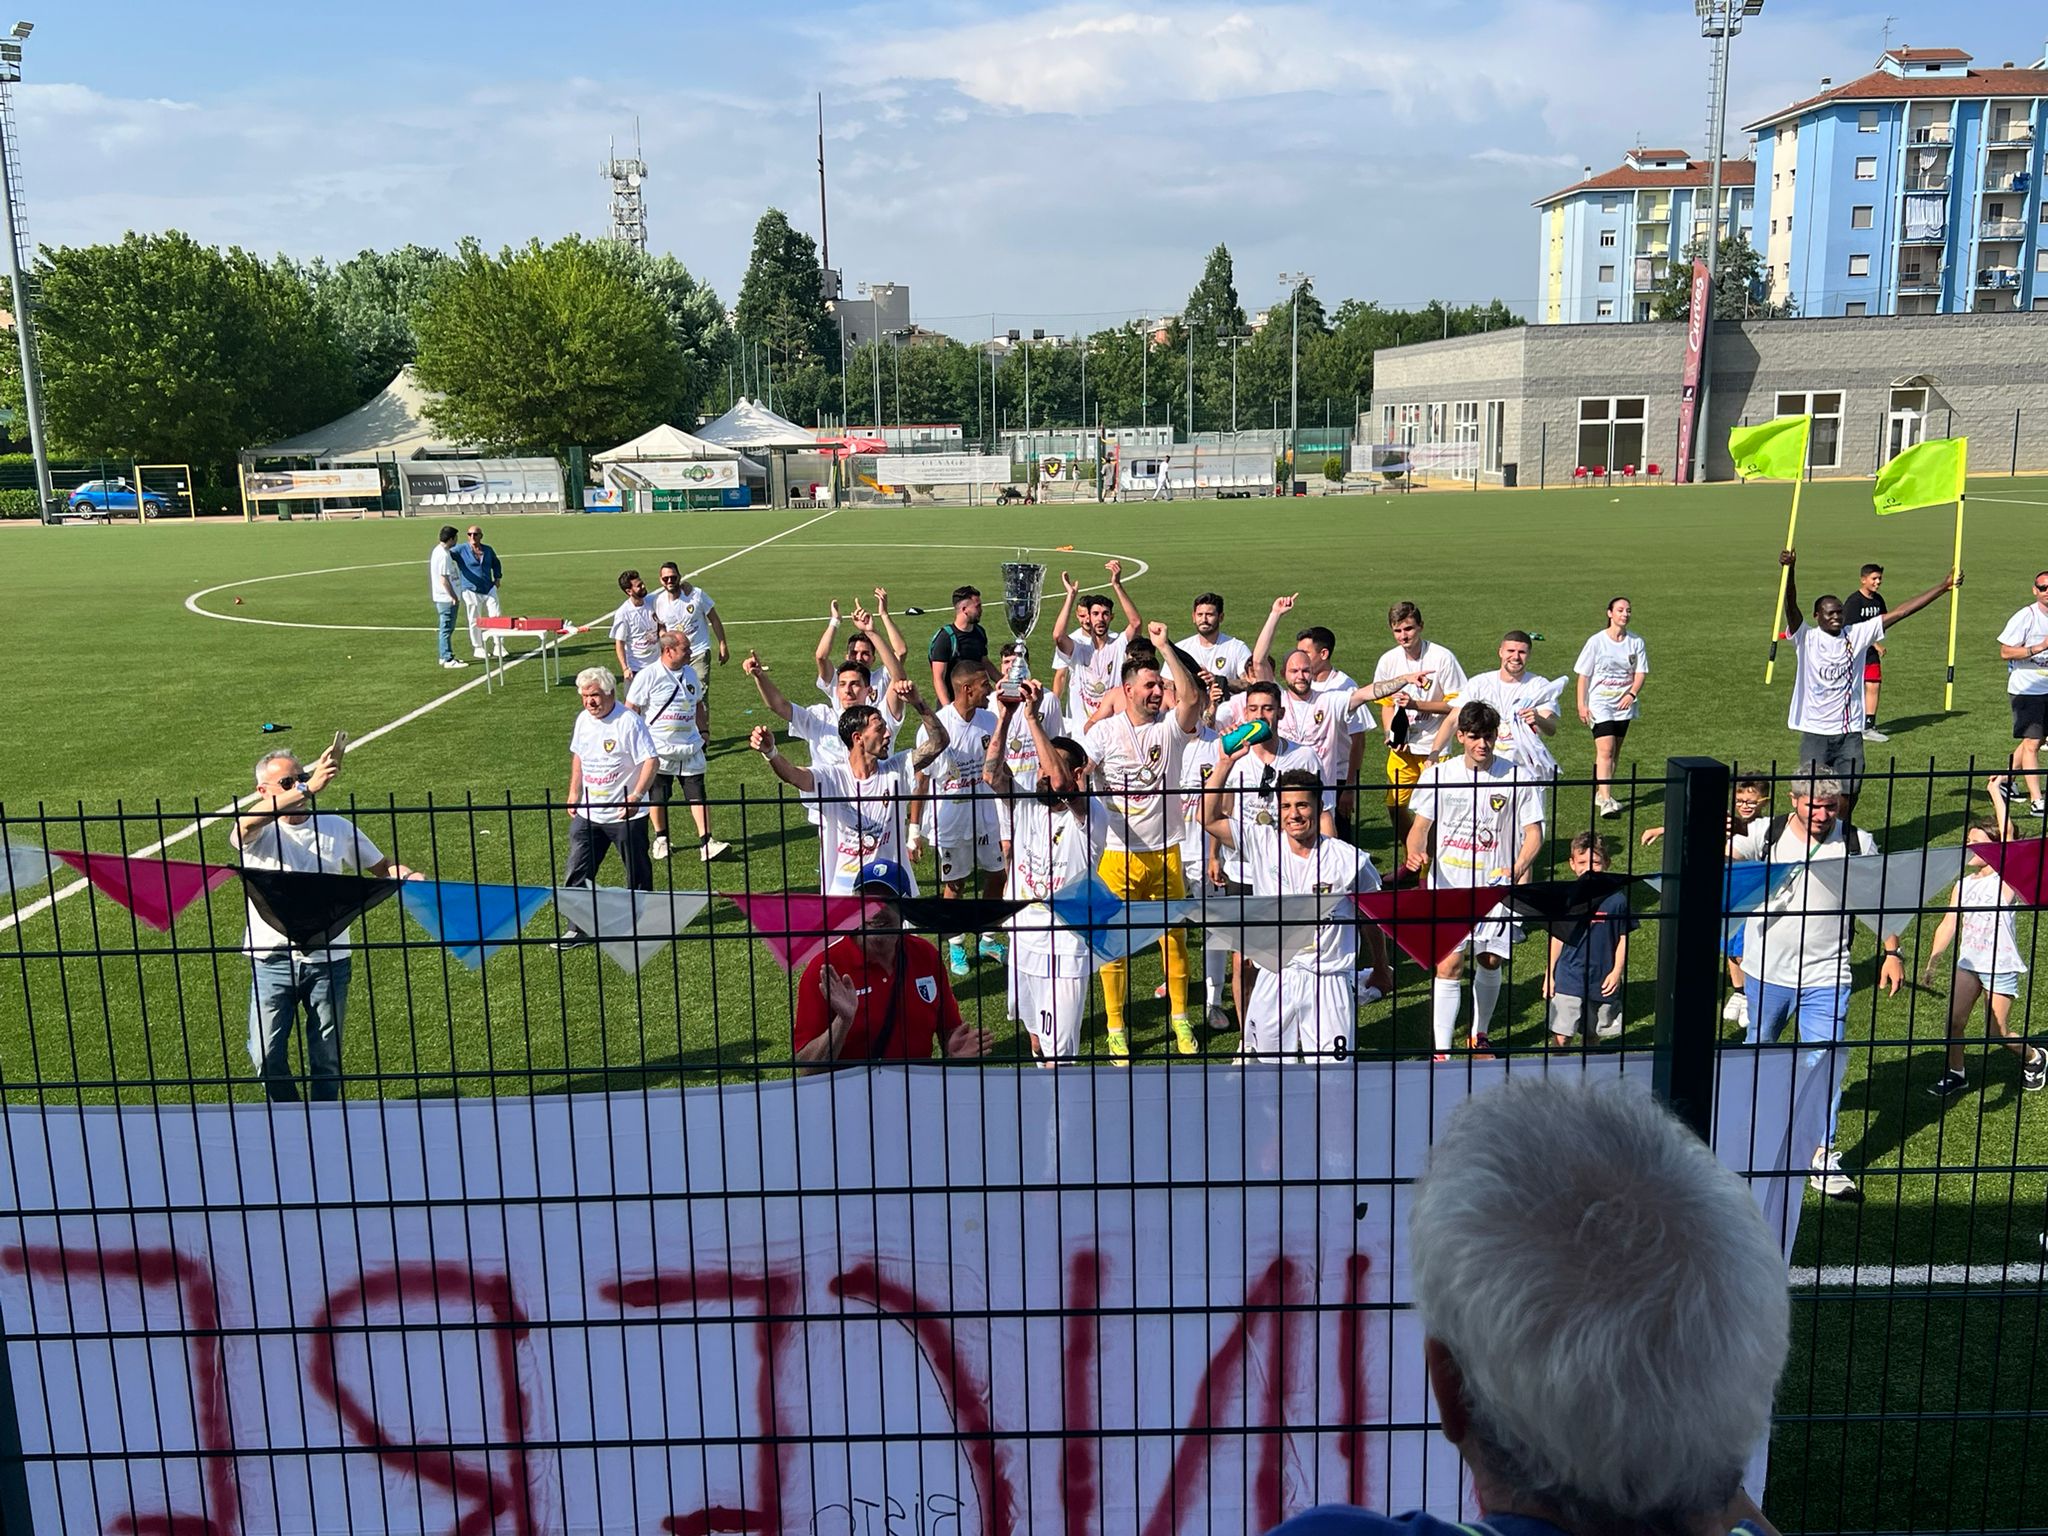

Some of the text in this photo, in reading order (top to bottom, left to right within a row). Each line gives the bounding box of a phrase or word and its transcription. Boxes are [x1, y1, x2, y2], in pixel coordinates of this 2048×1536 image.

[1689, 276, 1705, 353] Curves
[1040, 1009, 1053, 1037] 10
[1333, 1035, 1347, 1062] 8
